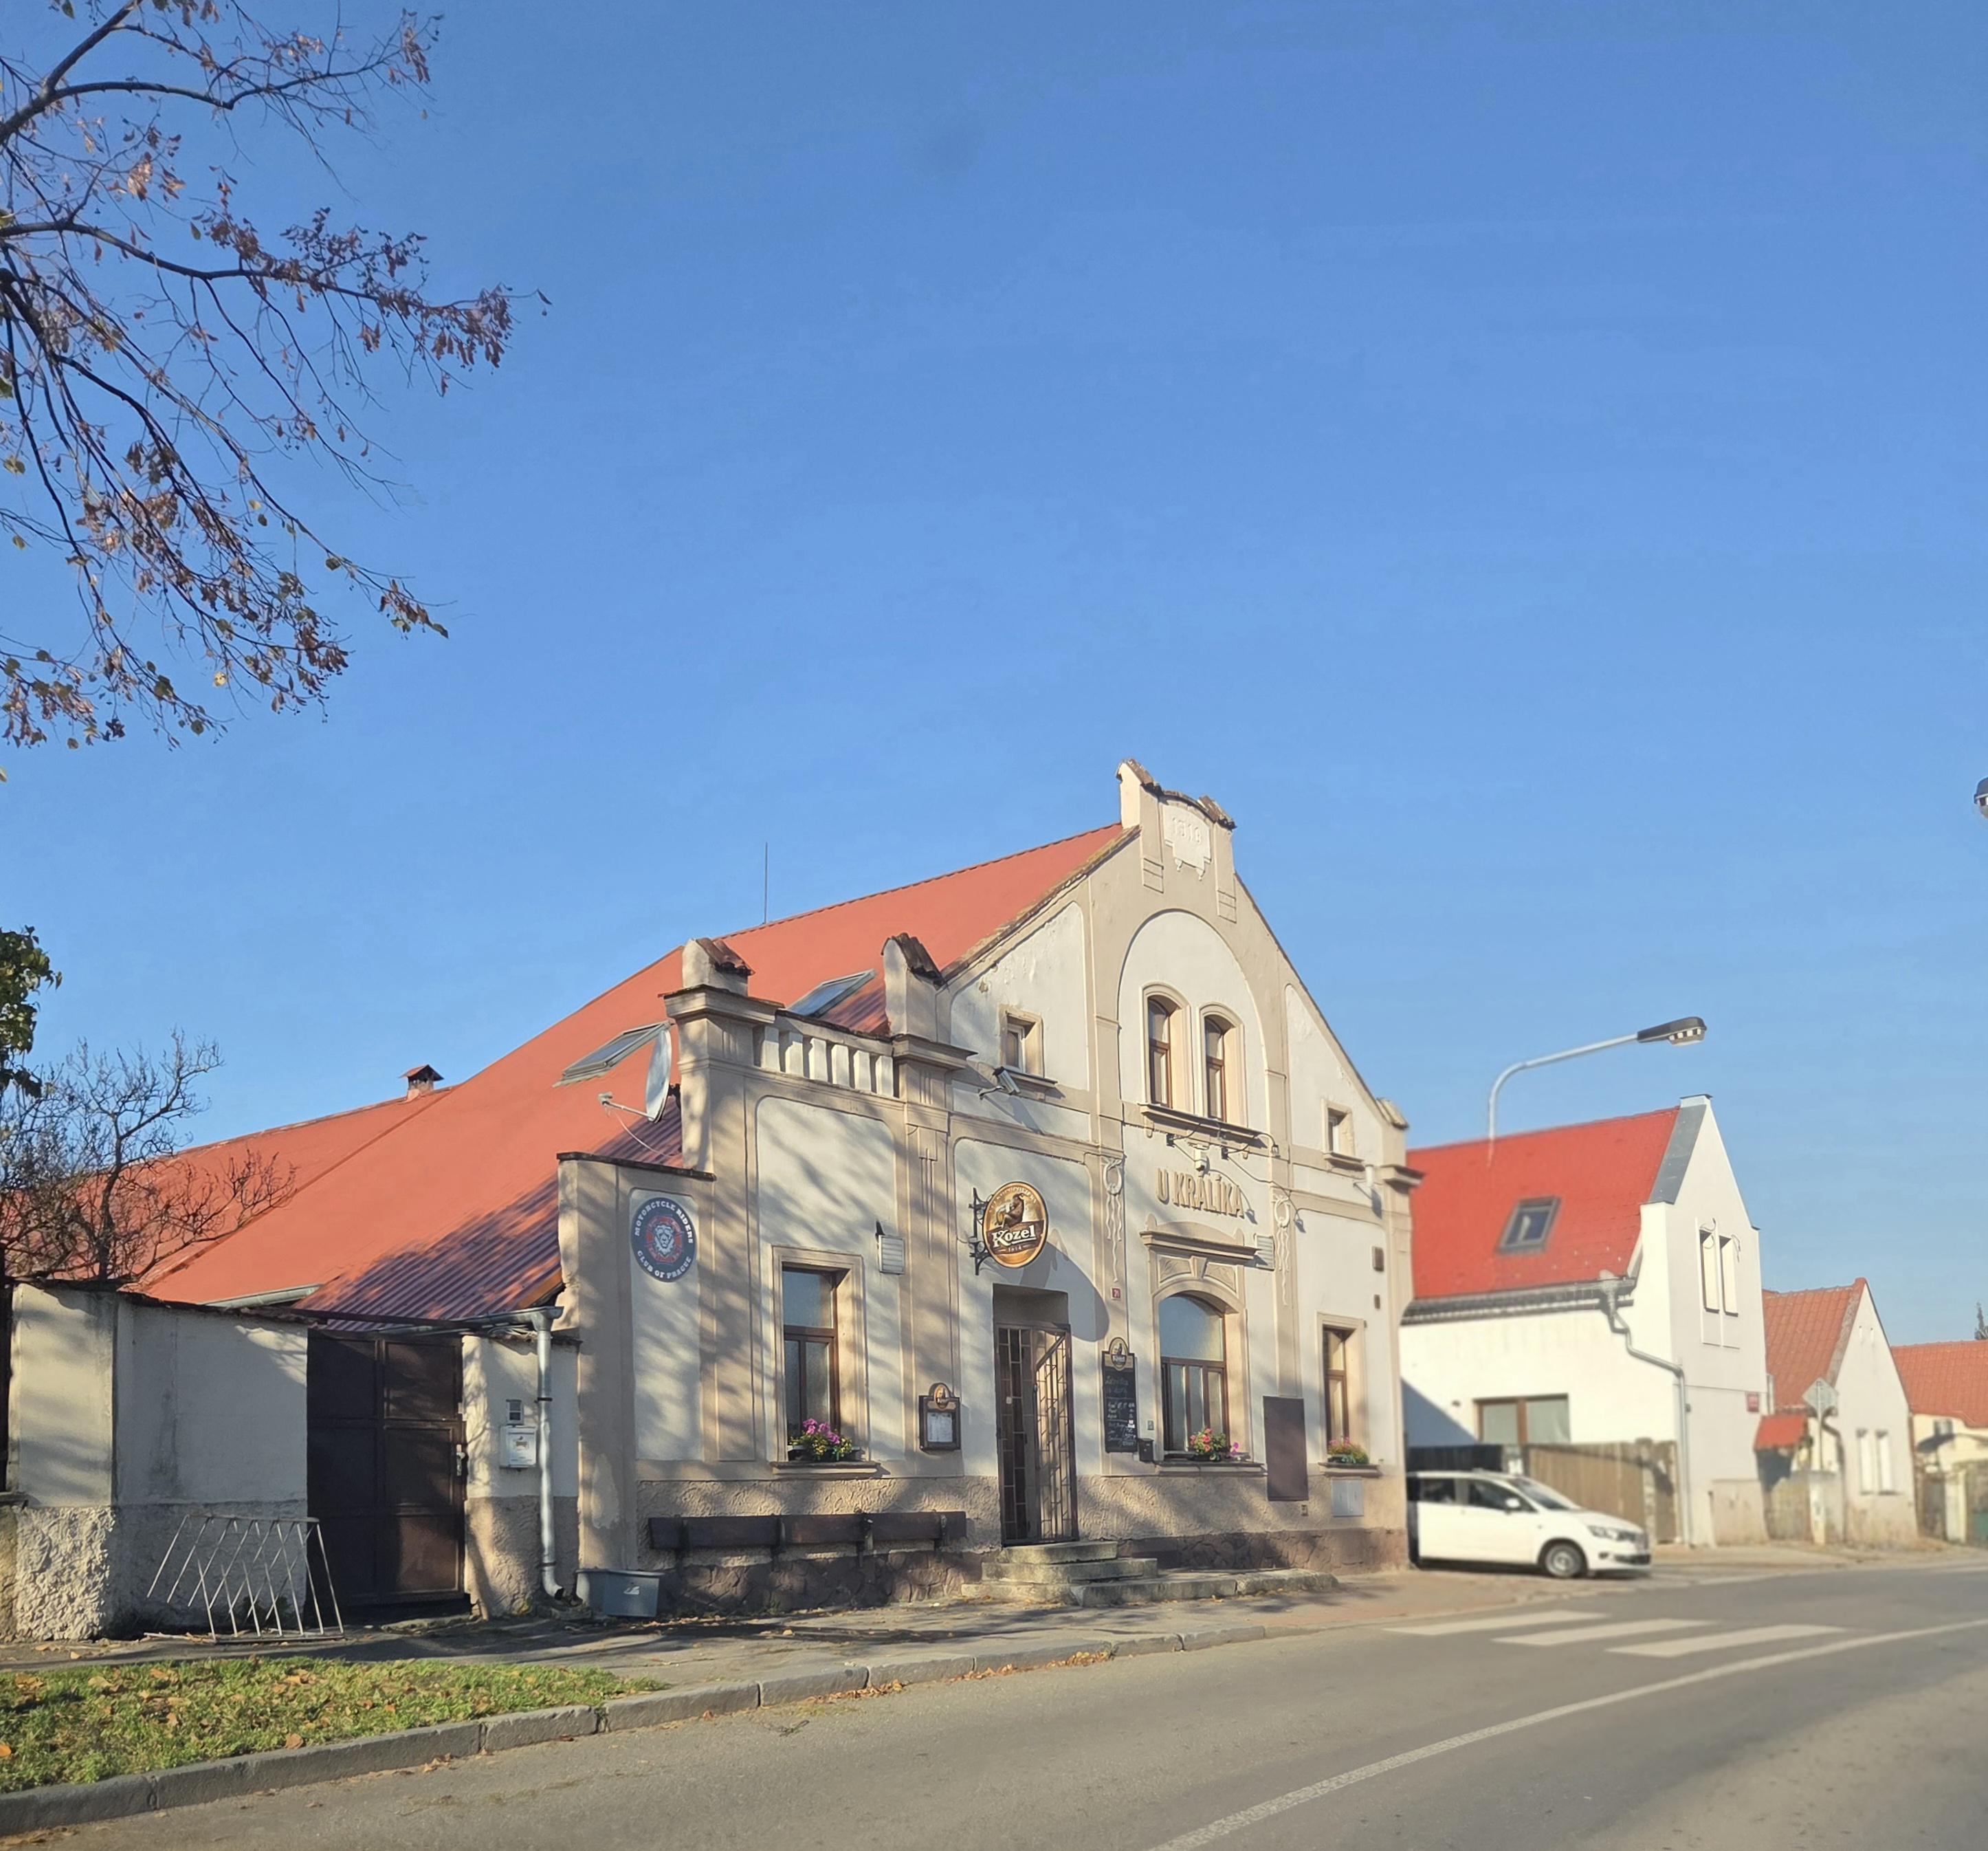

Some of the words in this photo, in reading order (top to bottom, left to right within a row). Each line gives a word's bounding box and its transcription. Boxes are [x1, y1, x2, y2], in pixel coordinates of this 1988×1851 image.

[1156, 1168, 1169, 1204] U
[1172, 1171, 1245, 1219] KRÁLÍKA
[634, 1201, 676, 1236] MOTORCYCLE
[676, 1208, 694, 1244] RIDERS
[992, 1225, 1037, 1248] Kozel
[637, 1250, 653, 1272] CLUB
[654, 1270, 665, 1278] OF
[666, 1256, 692, 1279] PRAGUE
